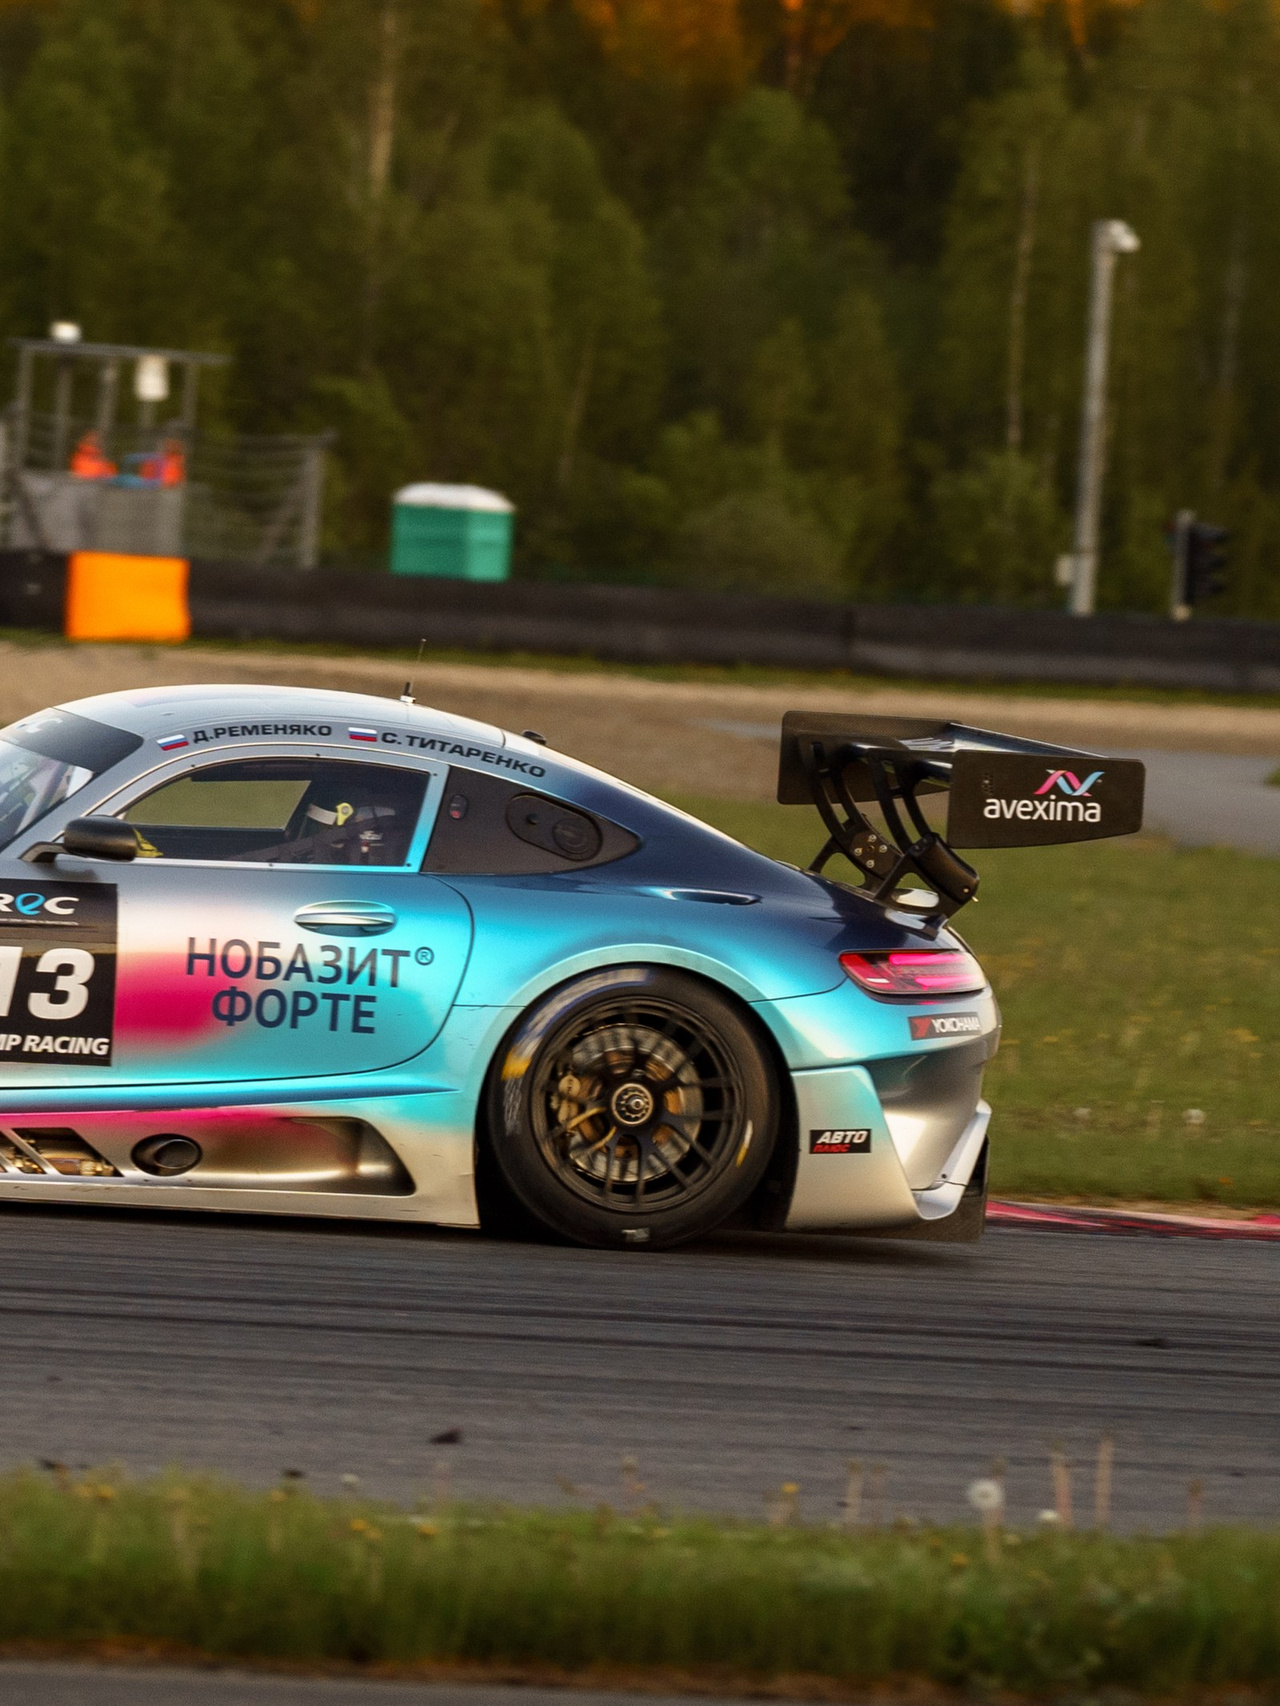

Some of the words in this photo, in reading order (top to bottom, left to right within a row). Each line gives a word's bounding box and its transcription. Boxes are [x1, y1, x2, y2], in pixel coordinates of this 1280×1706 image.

[983, 794, 1102, 823] avexima
[211, 986, 378, 1034] ФОРТЕ
[22, 1035, 110, 1056] RACING
[816, 1130, 869, 1144] АВТО
